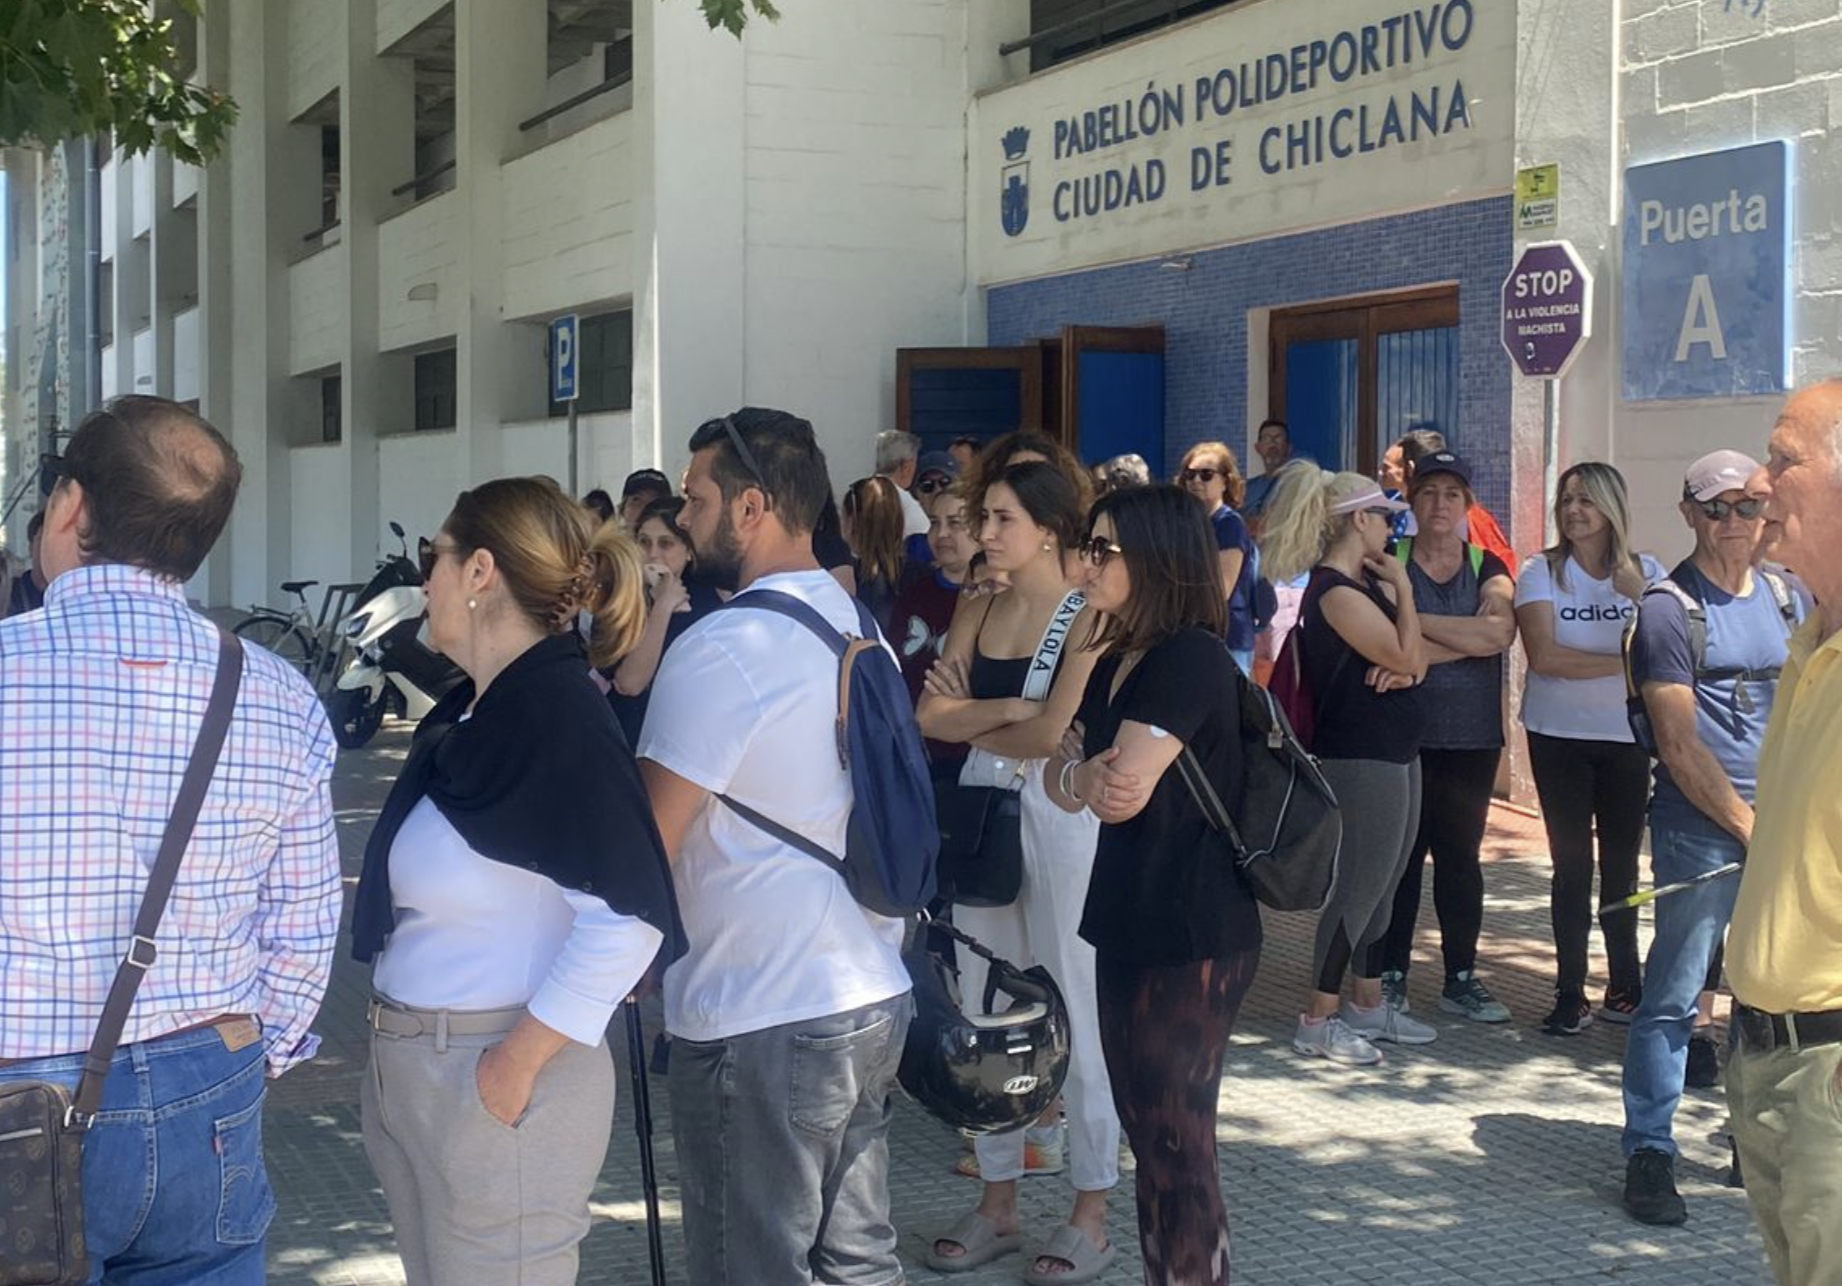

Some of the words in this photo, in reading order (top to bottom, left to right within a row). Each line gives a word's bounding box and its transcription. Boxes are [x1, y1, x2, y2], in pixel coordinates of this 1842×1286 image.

[1054, 81, 1184, 160] PABELLÓN
[1196, 0, 1474, 122] POLIDEPORTIVO
[1053, 158, 1166, 222] CIUDAD
[1191, 140, 1231, 191] DE
[1259, 79, 1471, 175] CHICLANA
[1640, 190, 1768, 246] Puerta
[1506, 309, 1513, 320] A
[1514, 308, 1527, 319] LA
[1528, 303, 1580, 318] VIOLENCIA
[1515, 269, 1573, 298] STOP
[1518, 322, 1566, 336] MACHISTA
[1674, 274, 1728, 363] A
[558, 327, 572, 389] P
